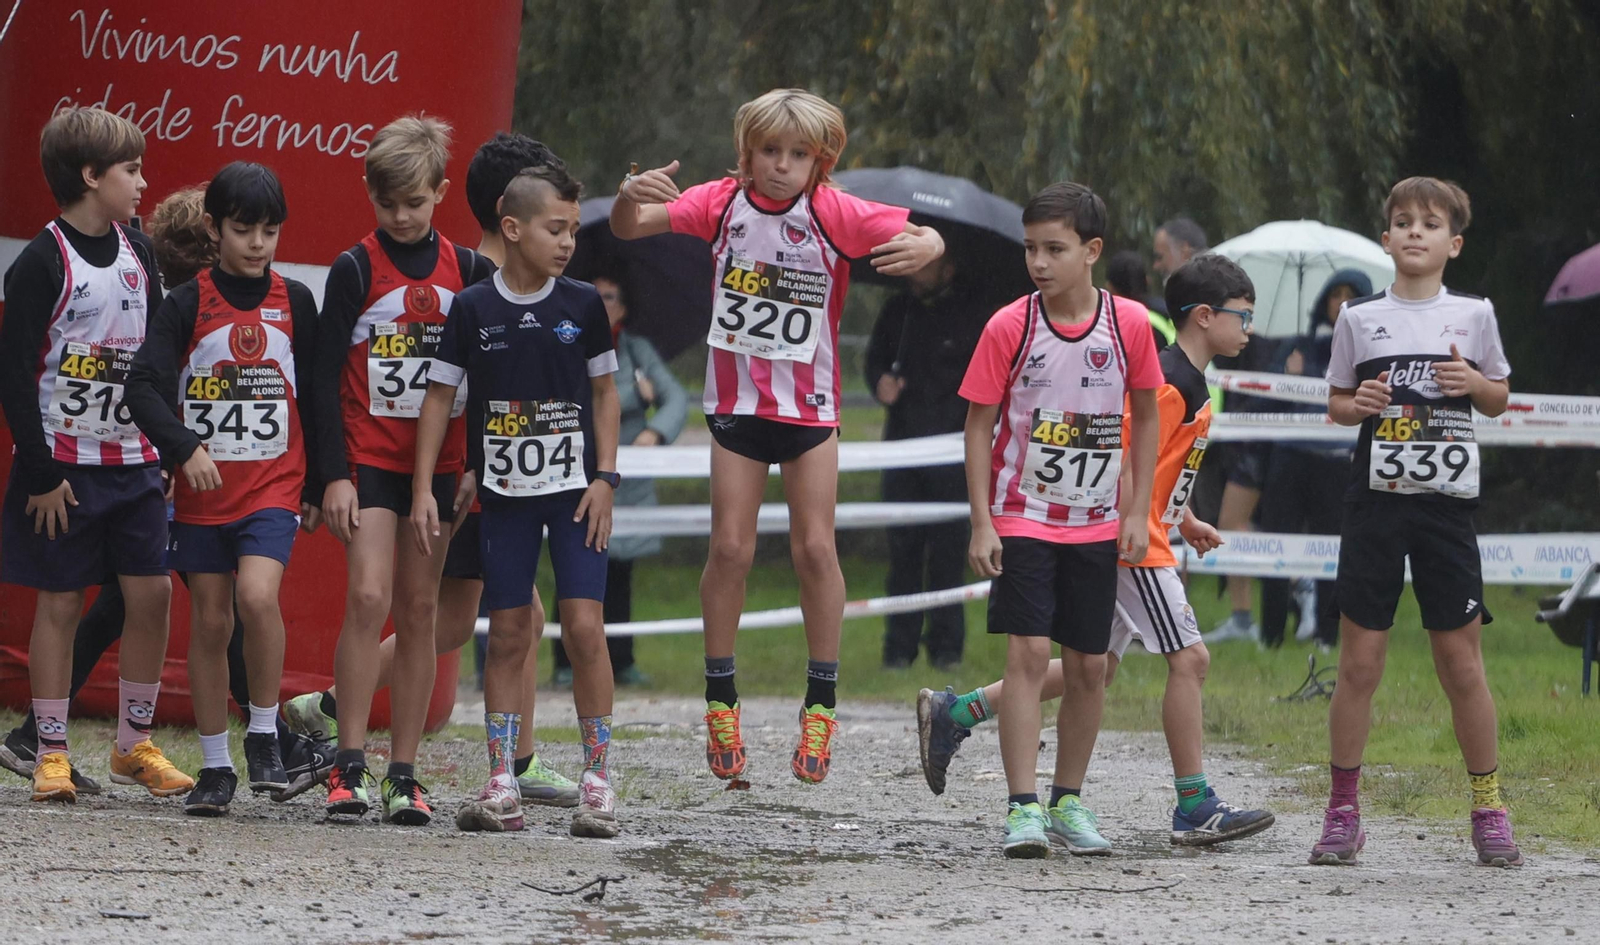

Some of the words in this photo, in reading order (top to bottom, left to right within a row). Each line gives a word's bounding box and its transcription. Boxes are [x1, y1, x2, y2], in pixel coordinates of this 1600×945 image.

[70, 9, 242, 70] Vivimos
[258, 31, 399, 84] nunha
[783, 271, 827, 285] MEMORIAL
[777, 279, 826, 294] BELARMINO
[789, 292, 823, 303] ALONSO
[717, 292, 812, 345] 320
[241, 368, 280, 377] MEMORIA
[237, 378, 285, 386] BELARMINO
[251, 387, 285, 395] ALONSO
[1276, 383, 1316, 395] CONCELLO
[1540, 402, 1581, 414] CONCELLO
[1583, 404, 1593, 414] DE
[1433, 409, 1471, 420] MEMORIAL
[189, 403, 280, 441] 343
[549, 419, 580, 430] ALONSO
[1428, 419, 1473, 429] BELARMINO
[1442, 429, 1473, 438] ALONSO
[1096, 436, 1120, 445] ALONSO
[488, 436, 576, 476] 304
[1034, 447, 1112, 488] 317
[1375, 444, 1469, 482] 339
